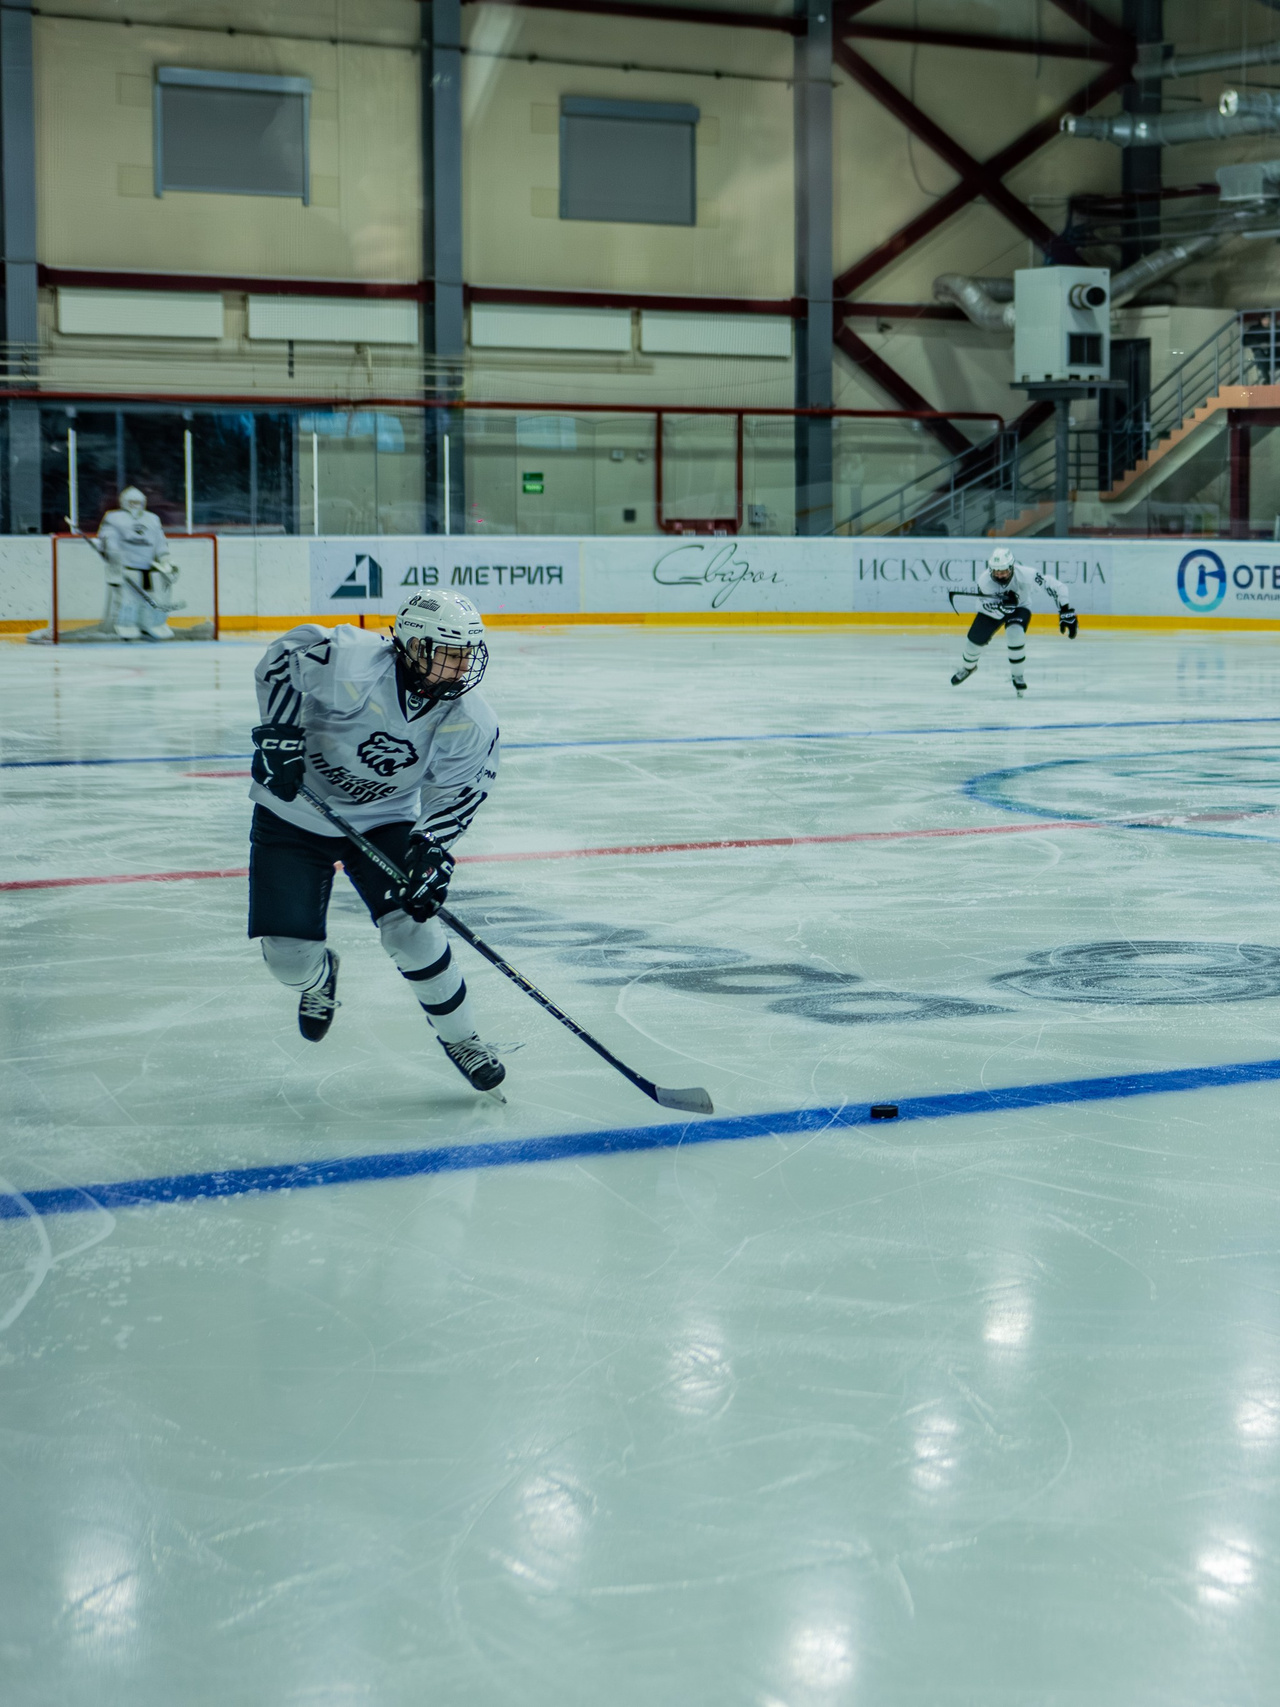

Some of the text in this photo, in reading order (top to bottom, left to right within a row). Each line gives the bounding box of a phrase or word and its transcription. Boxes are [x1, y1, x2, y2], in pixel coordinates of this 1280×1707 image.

[400, 566, 563, 586] ДВ МЕТРИЯ
[1035, 560, 1106, 584] ТЕЛА
[403, 620, 424, 629] CCM
